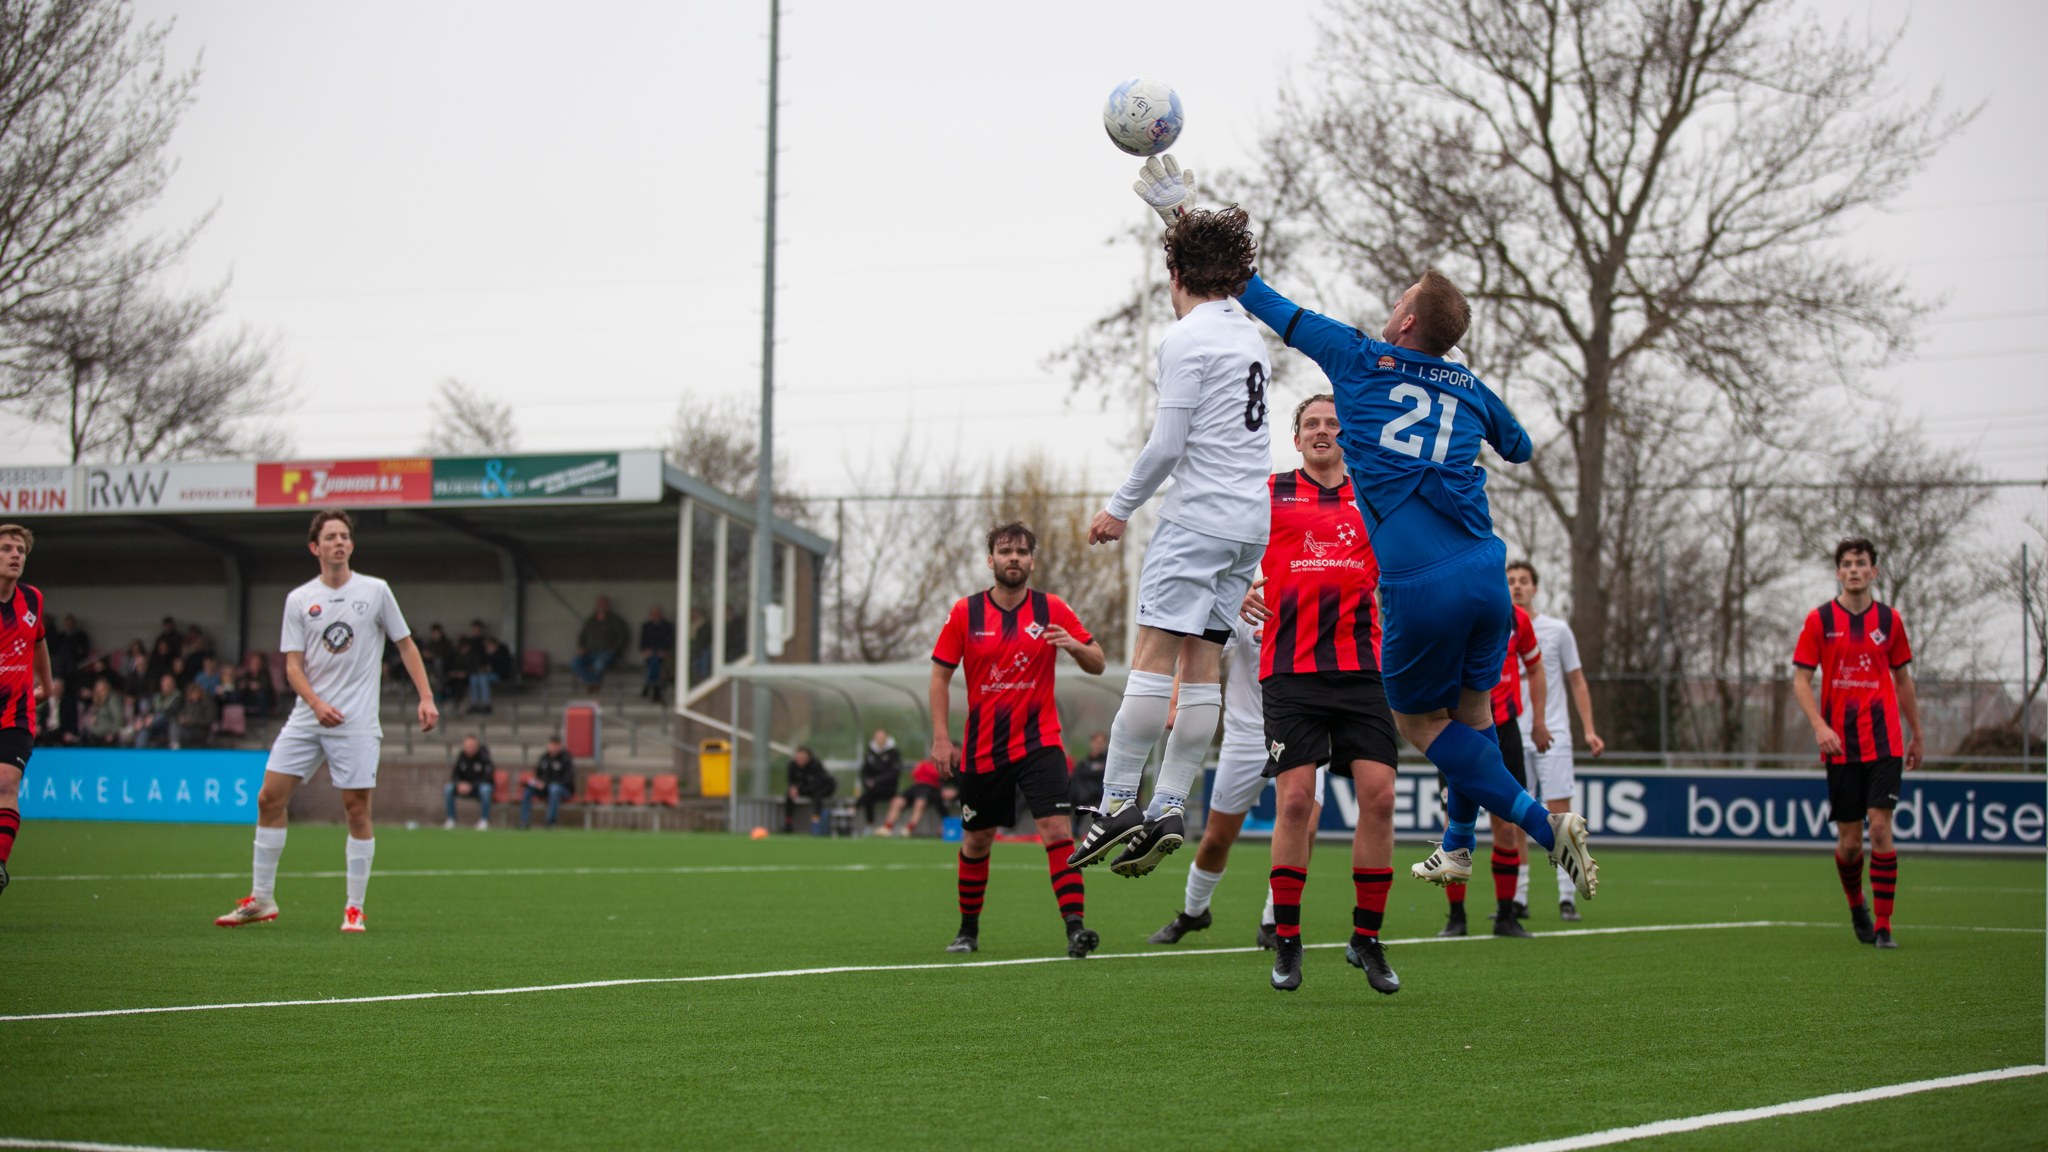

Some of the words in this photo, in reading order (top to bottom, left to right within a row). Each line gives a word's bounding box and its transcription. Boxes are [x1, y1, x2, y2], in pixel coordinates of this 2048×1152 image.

[1244, 360, 1266, 433] 8
[1429, 367, 1475, 390] SPORT
[1379, 382, 1459, 465] 21
[18, 487, 67, 512] RIJN
[1688, 785, 2045, 842] bouwdvise
